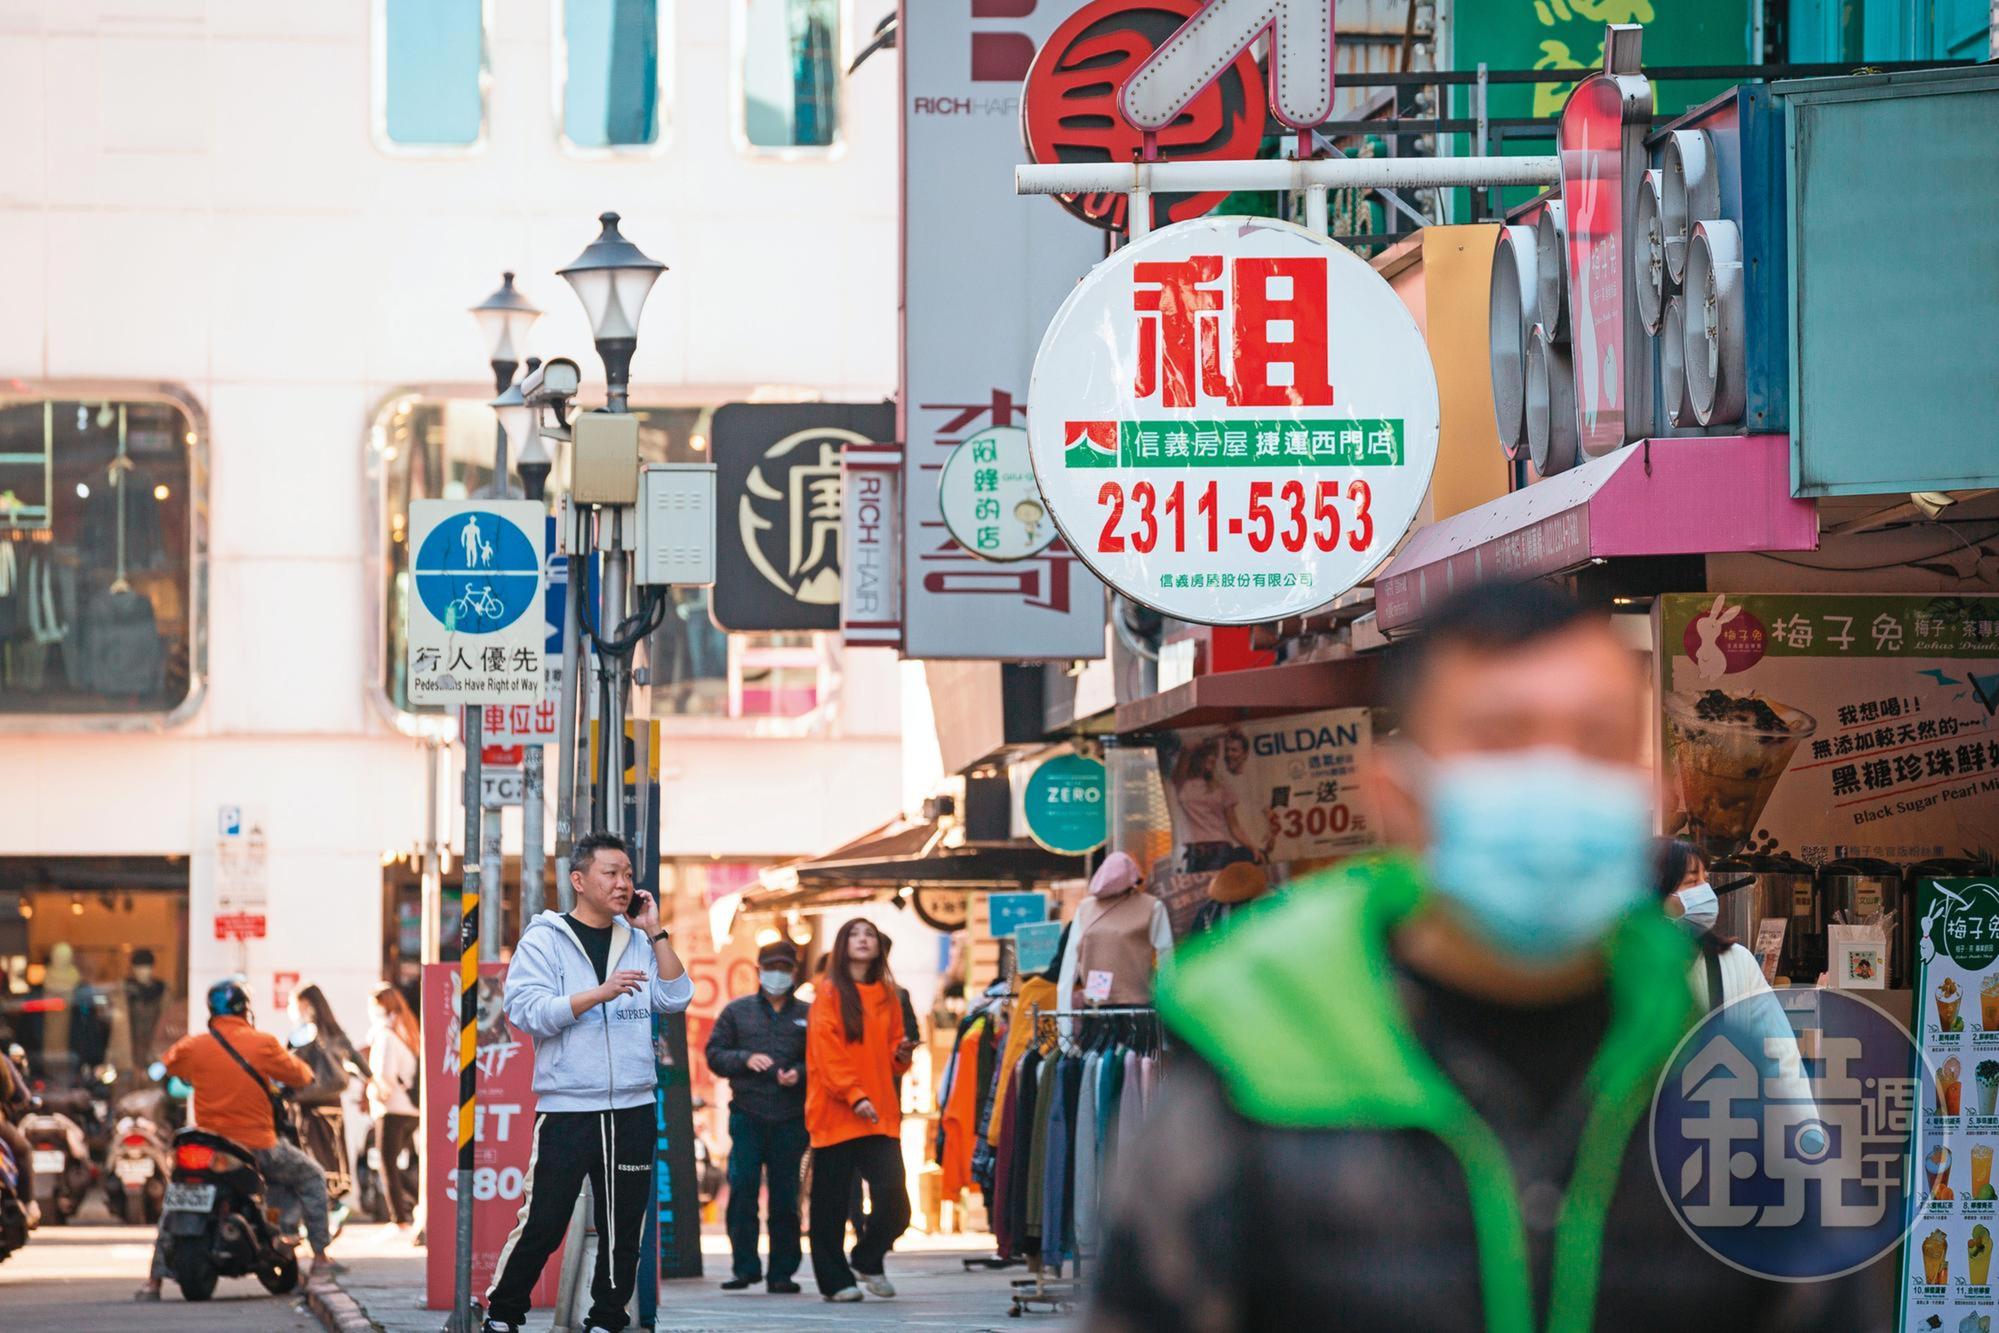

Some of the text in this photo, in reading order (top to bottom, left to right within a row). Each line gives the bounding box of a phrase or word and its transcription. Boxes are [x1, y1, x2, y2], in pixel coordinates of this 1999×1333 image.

[1134, 255, 1333, 407] 租
[1134, 430, 1393, 458] 信義房屋 捷運西門店
[1097, 480, 1374, 554] 2311-5353
[1771, 612, 1903, 651] 梅子兔
[414, 646, 538, 673] 行人優先
[465, 677, 485, 691] Have
[487, 677, 509, 694] Right
[511, 677, 520, 691] of
[521, 677, 538, 693] Way
[1254, 722, 1358, 756] GILDAN
[1047, 786, 1101, 803] ZERO
[1854, 803, 1894, 825] Black
[1897, 794, 1938, 813] Sugar
[1942, 784, 1977, 802] Pearl
